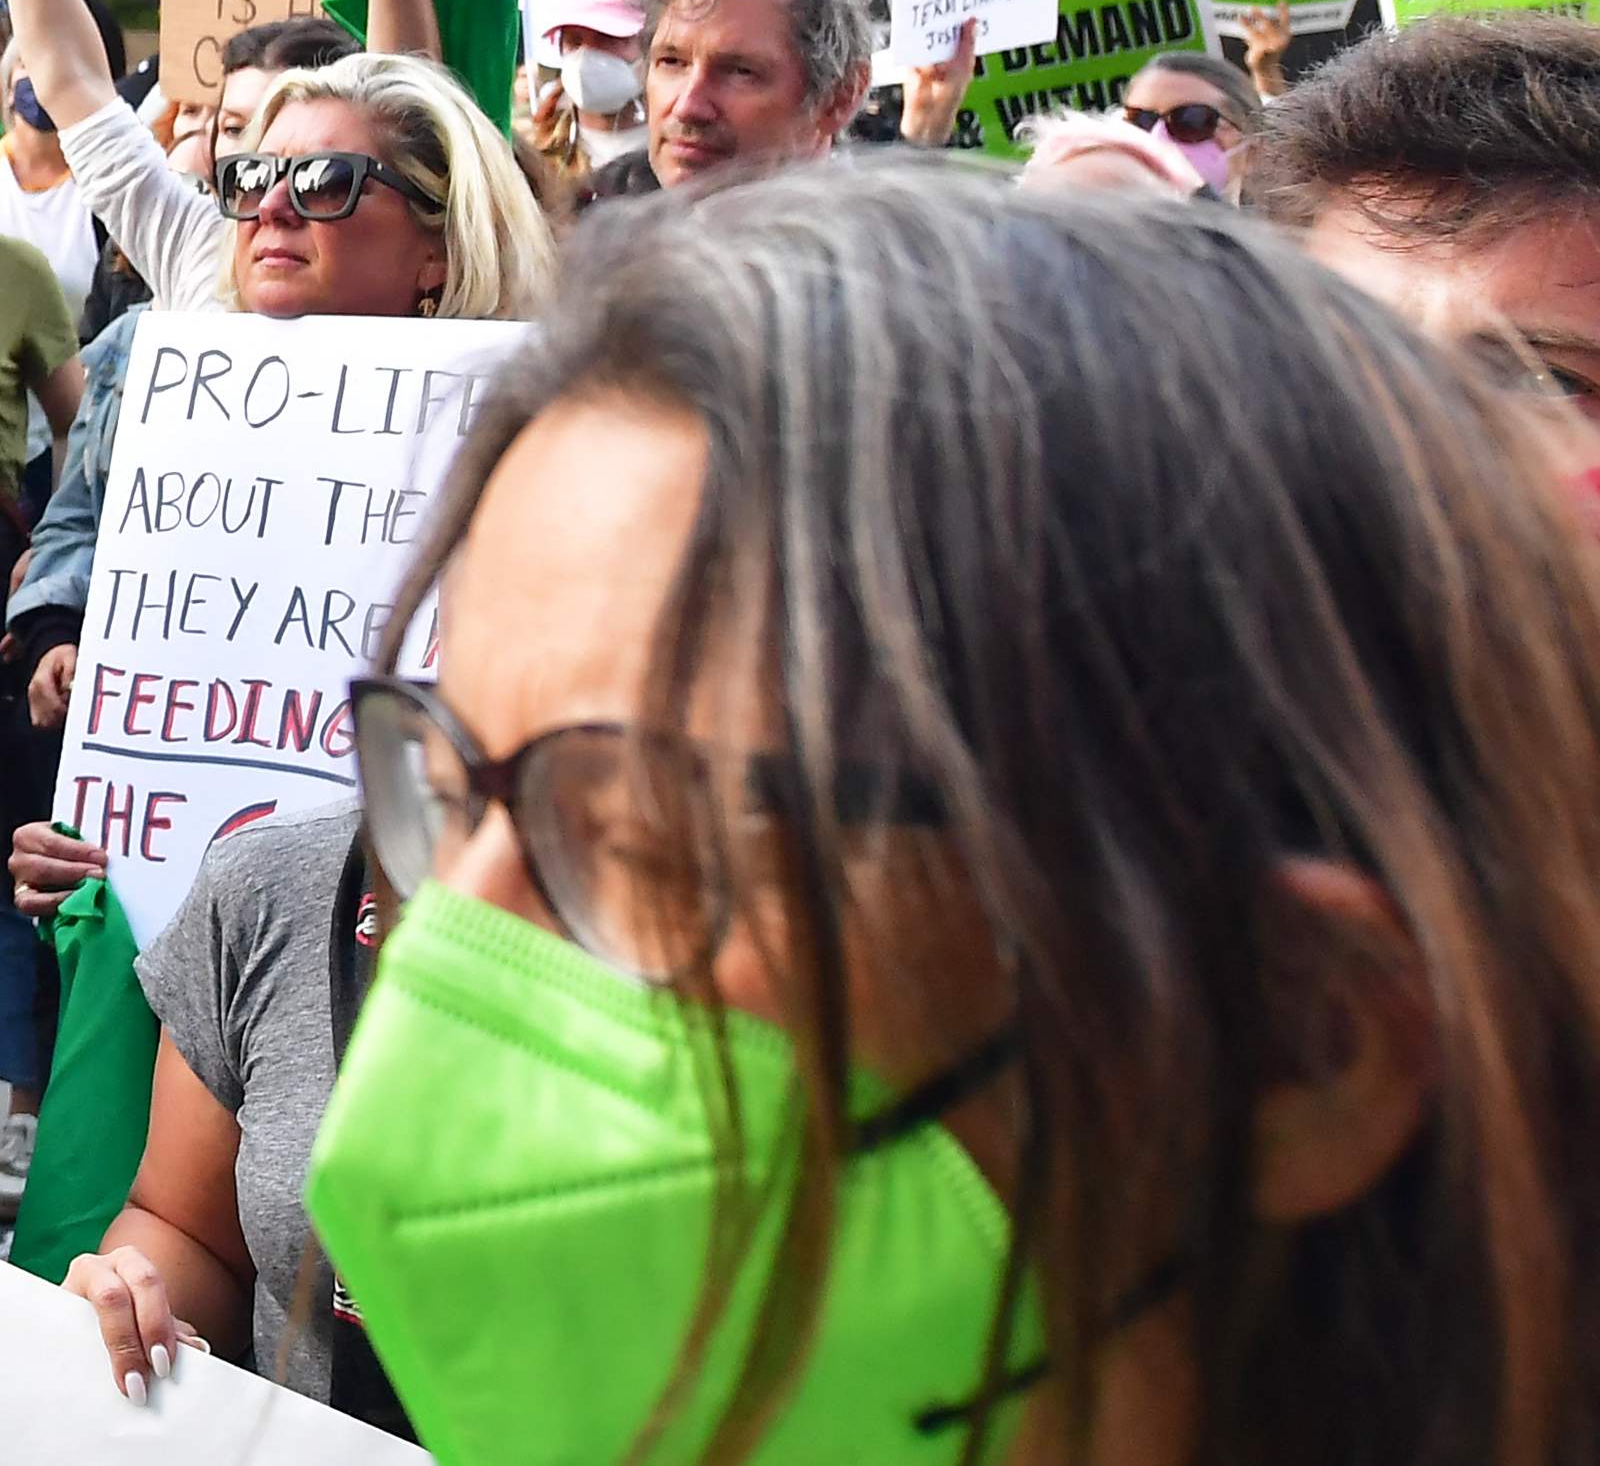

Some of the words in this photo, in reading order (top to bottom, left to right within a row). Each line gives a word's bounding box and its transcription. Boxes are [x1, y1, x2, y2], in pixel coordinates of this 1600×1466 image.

[118, 467, 284, 539] ABOUT
[102, 569, 258, 642] THEY
[274, 585, 394, 662] ARE
[86, 663, 357, 757] FEEDING
[72, 776, 187, 862] THE
